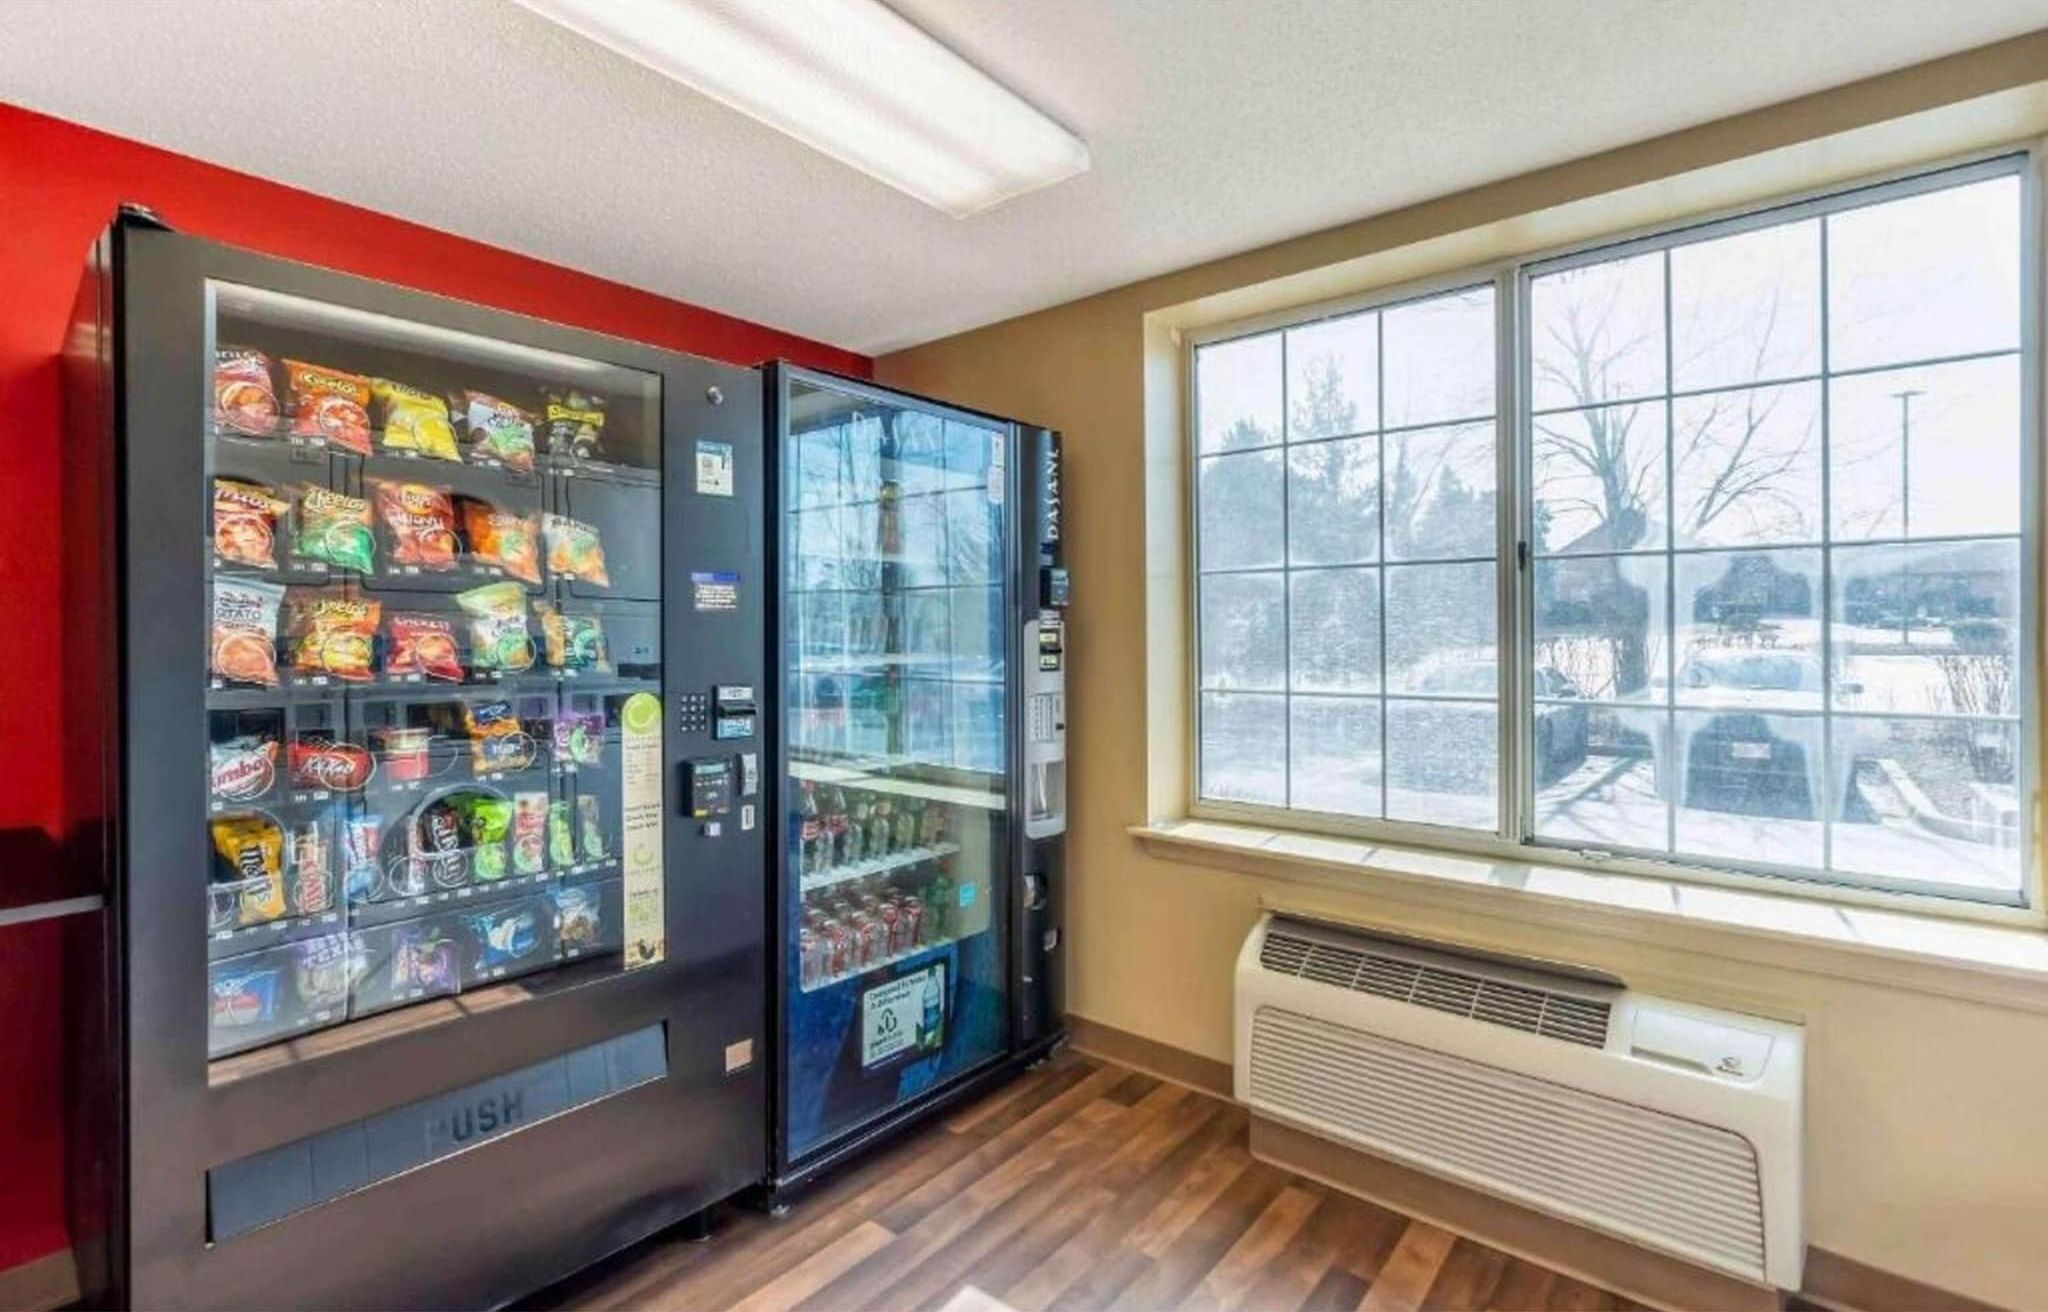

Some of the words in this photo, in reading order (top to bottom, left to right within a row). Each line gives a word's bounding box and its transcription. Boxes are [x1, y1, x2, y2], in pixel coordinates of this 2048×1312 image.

[1047, 448, 1061, 541] DASANI
[215, 607, 262, 622] OTATO
[426, 1088, 524, 1152] PUSH
